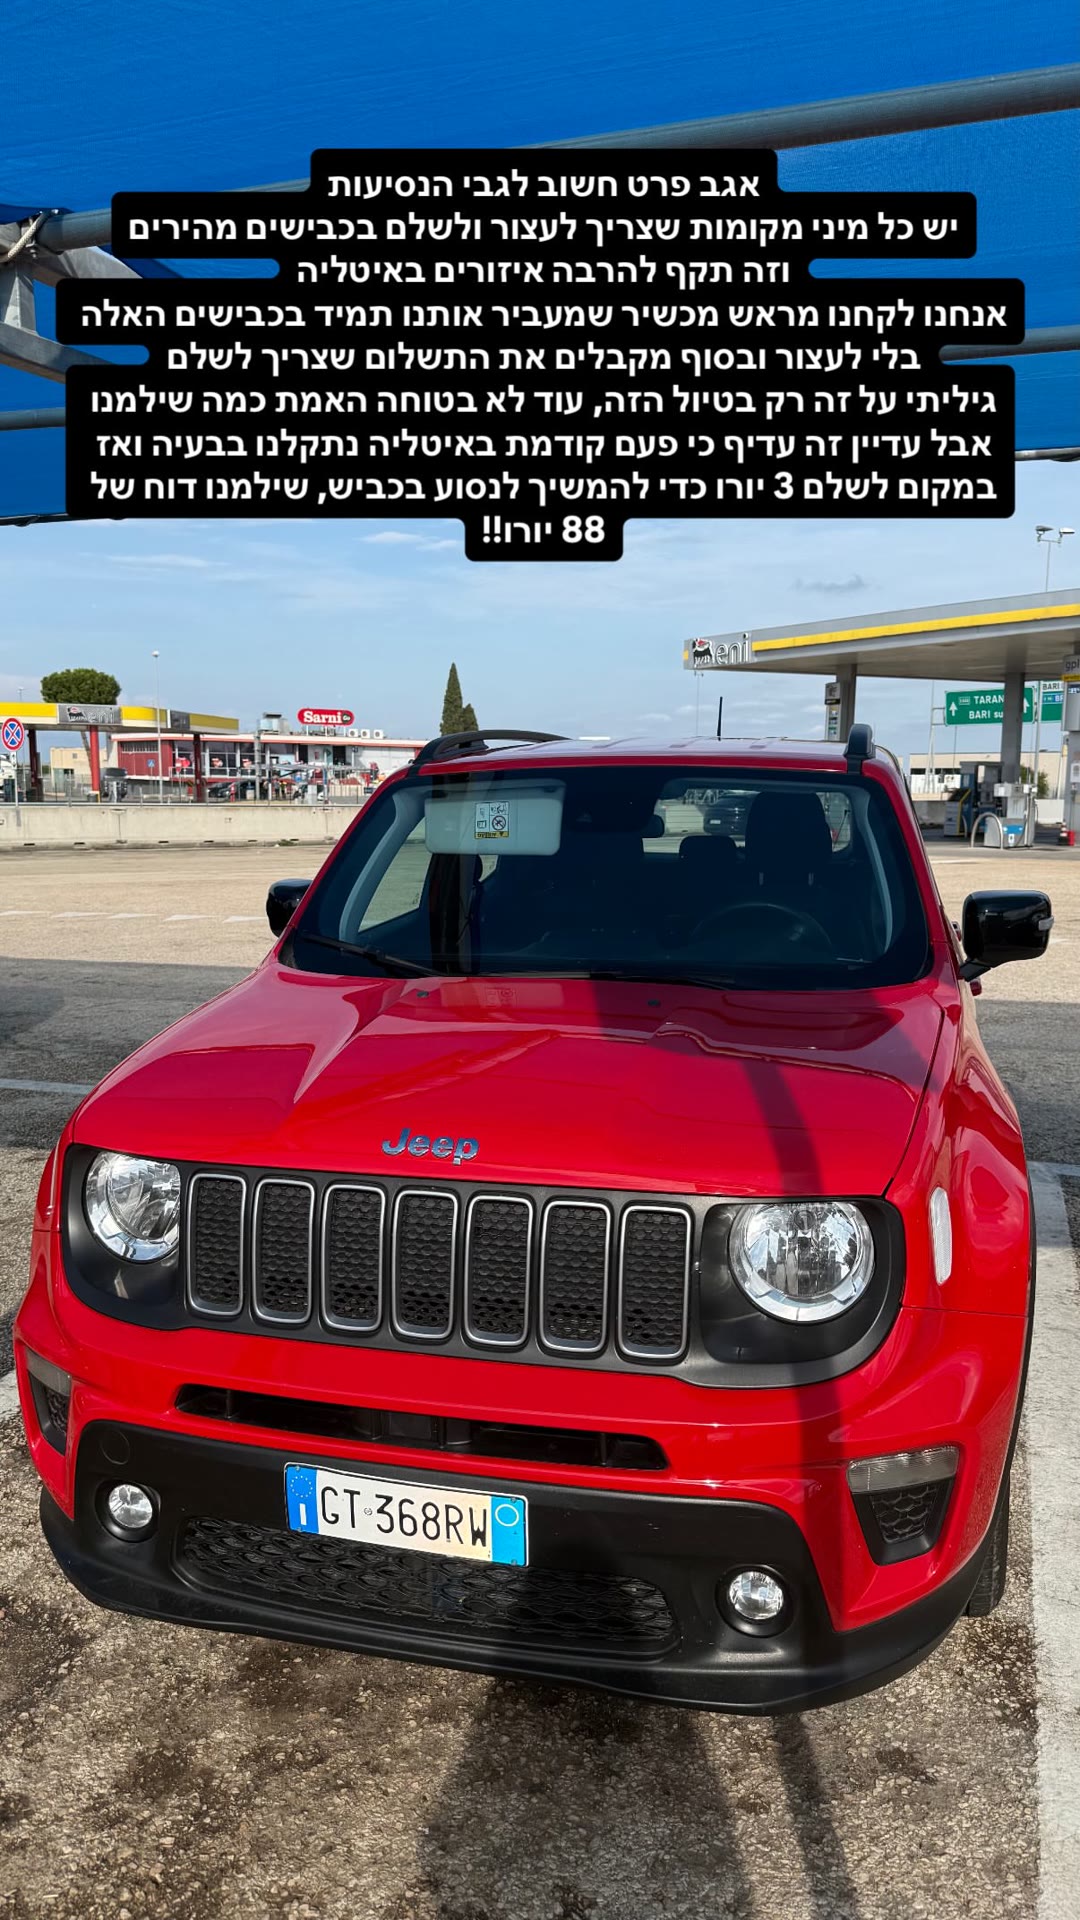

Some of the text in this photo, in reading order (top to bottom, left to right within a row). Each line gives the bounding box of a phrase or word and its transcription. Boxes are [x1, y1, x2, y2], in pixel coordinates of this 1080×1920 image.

[715, 632, 749, 665] eni
[1042, 682, 1060, 690] BARI
[973, 694, 1004, 705] TARAN
[303, 710, 343, 724] Sarni
[968, 709, 1004, 720] BARI su
[381, 1127, 480, 1166] Jeep
[321, 1485, 361, 1529] GT
